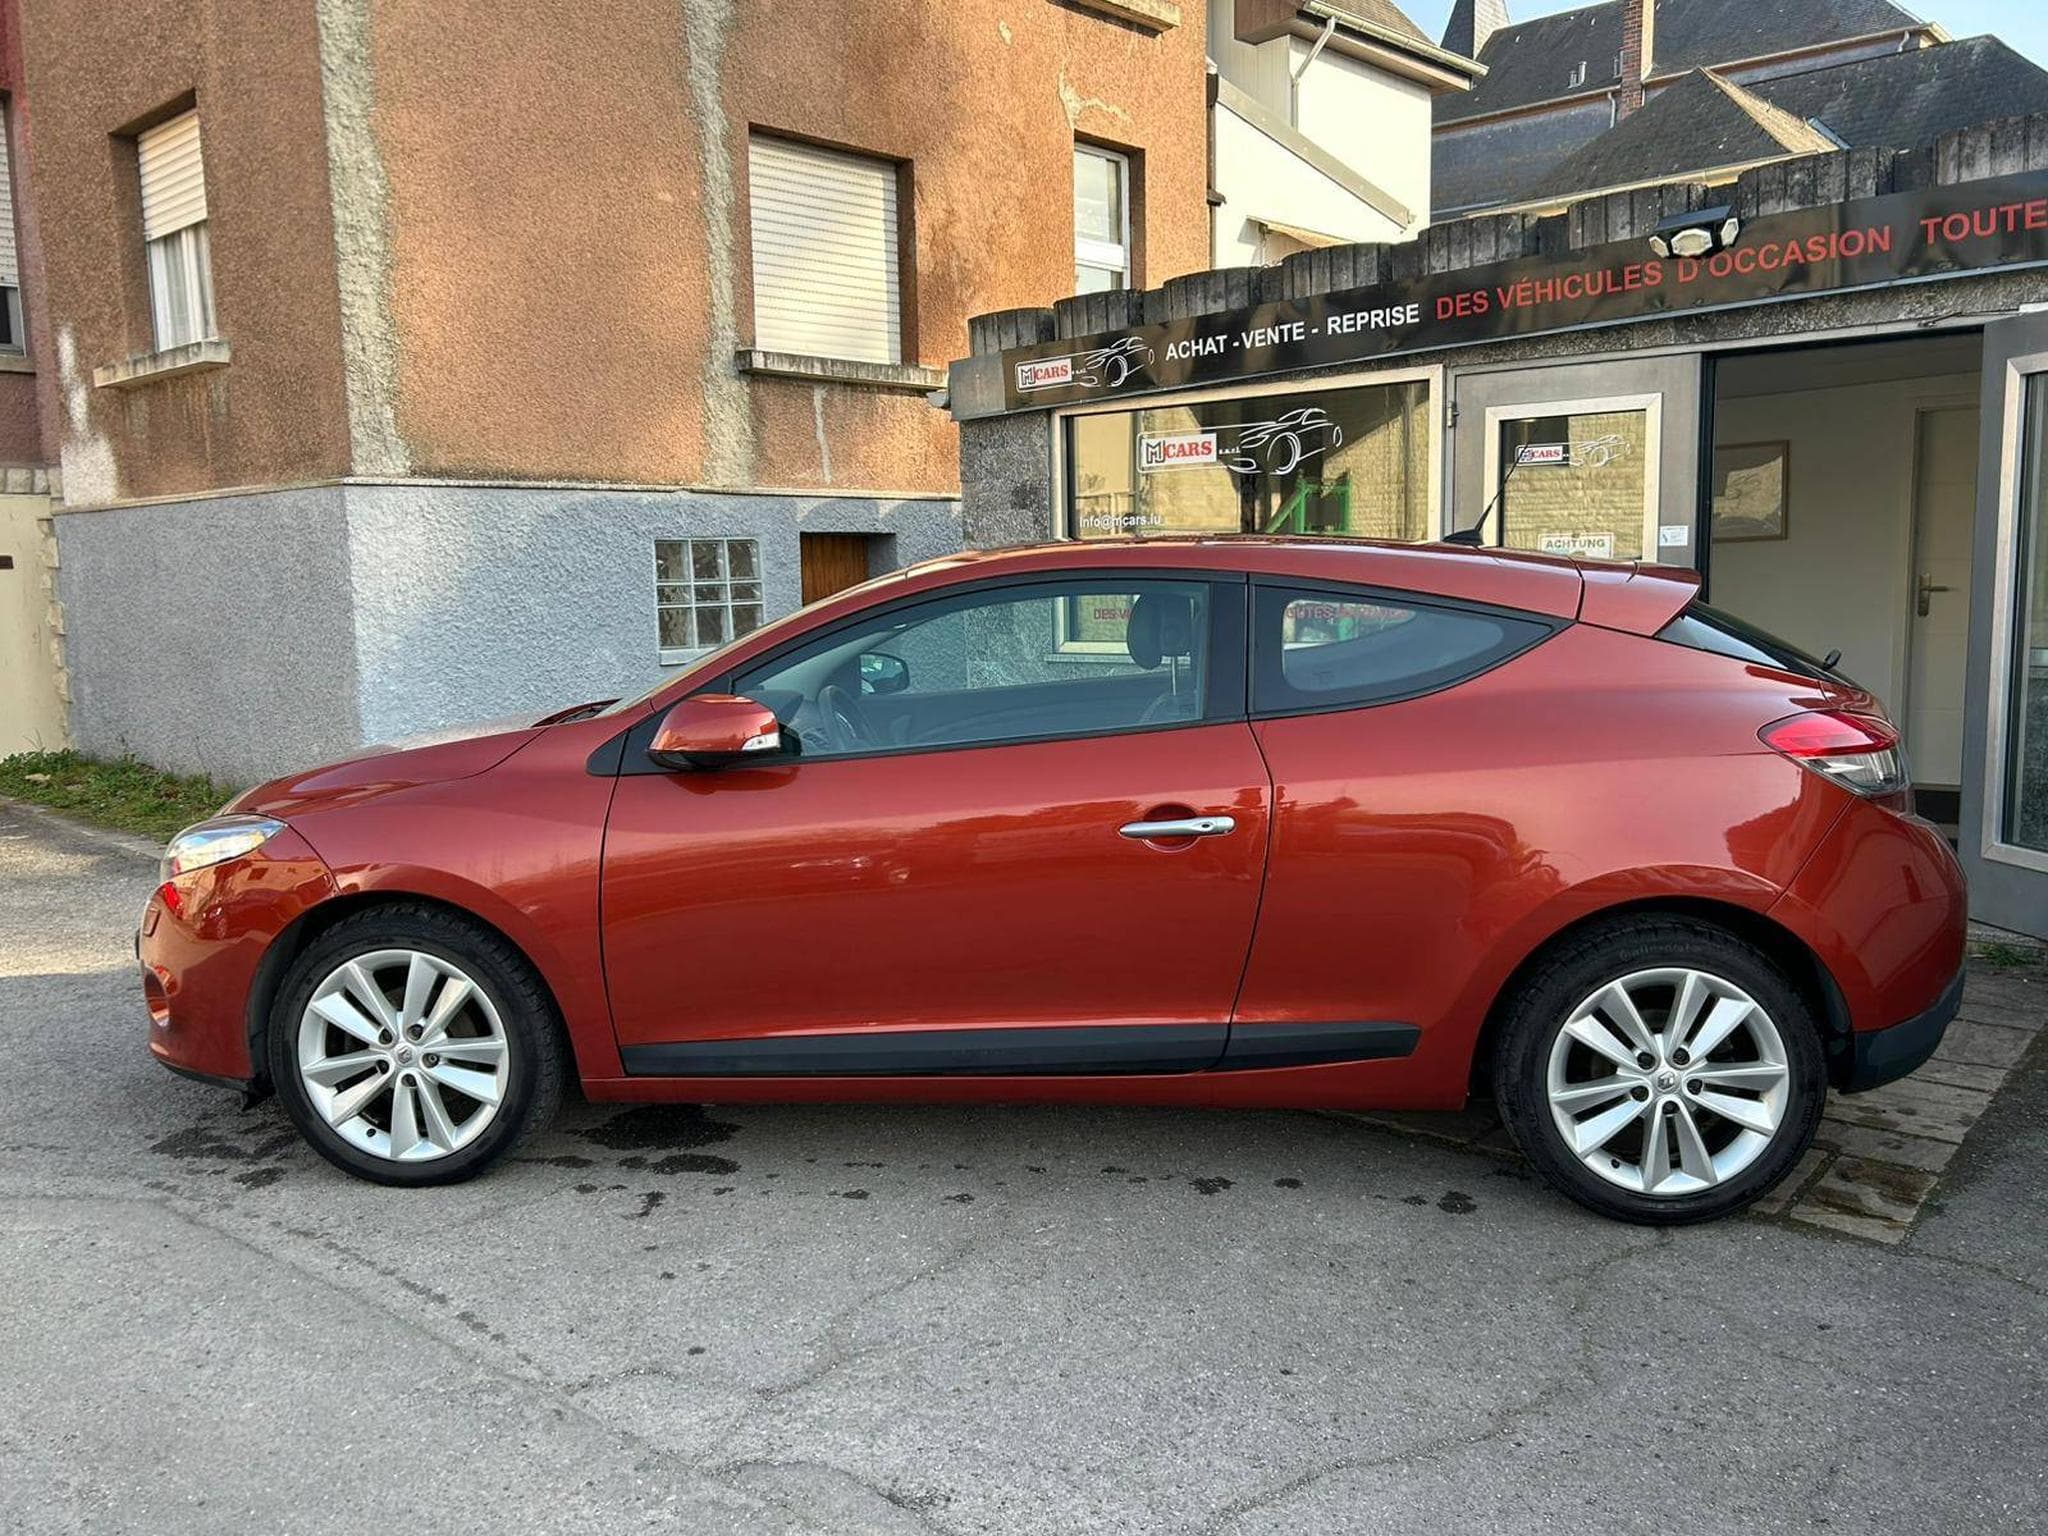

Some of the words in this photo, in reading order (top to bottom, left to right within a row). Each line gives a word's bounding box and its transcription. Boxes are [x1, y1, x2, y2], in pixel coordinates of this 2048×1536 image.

[1165, 335, 1228, 361] ACHAT
[1241, 322, 1305, 349] VENTE
[1327, 304, 1420, 335] REPRISE
[1436, 290, 1489, 320] DES
[1497, 260, 1663, 309] VÉHICULES
[1677, 225, 1892, 284] D'OCCASION
[1920, 199, 2048, 244] TOUTE
[1546, 538, 1605, 549] ACHTUNG
